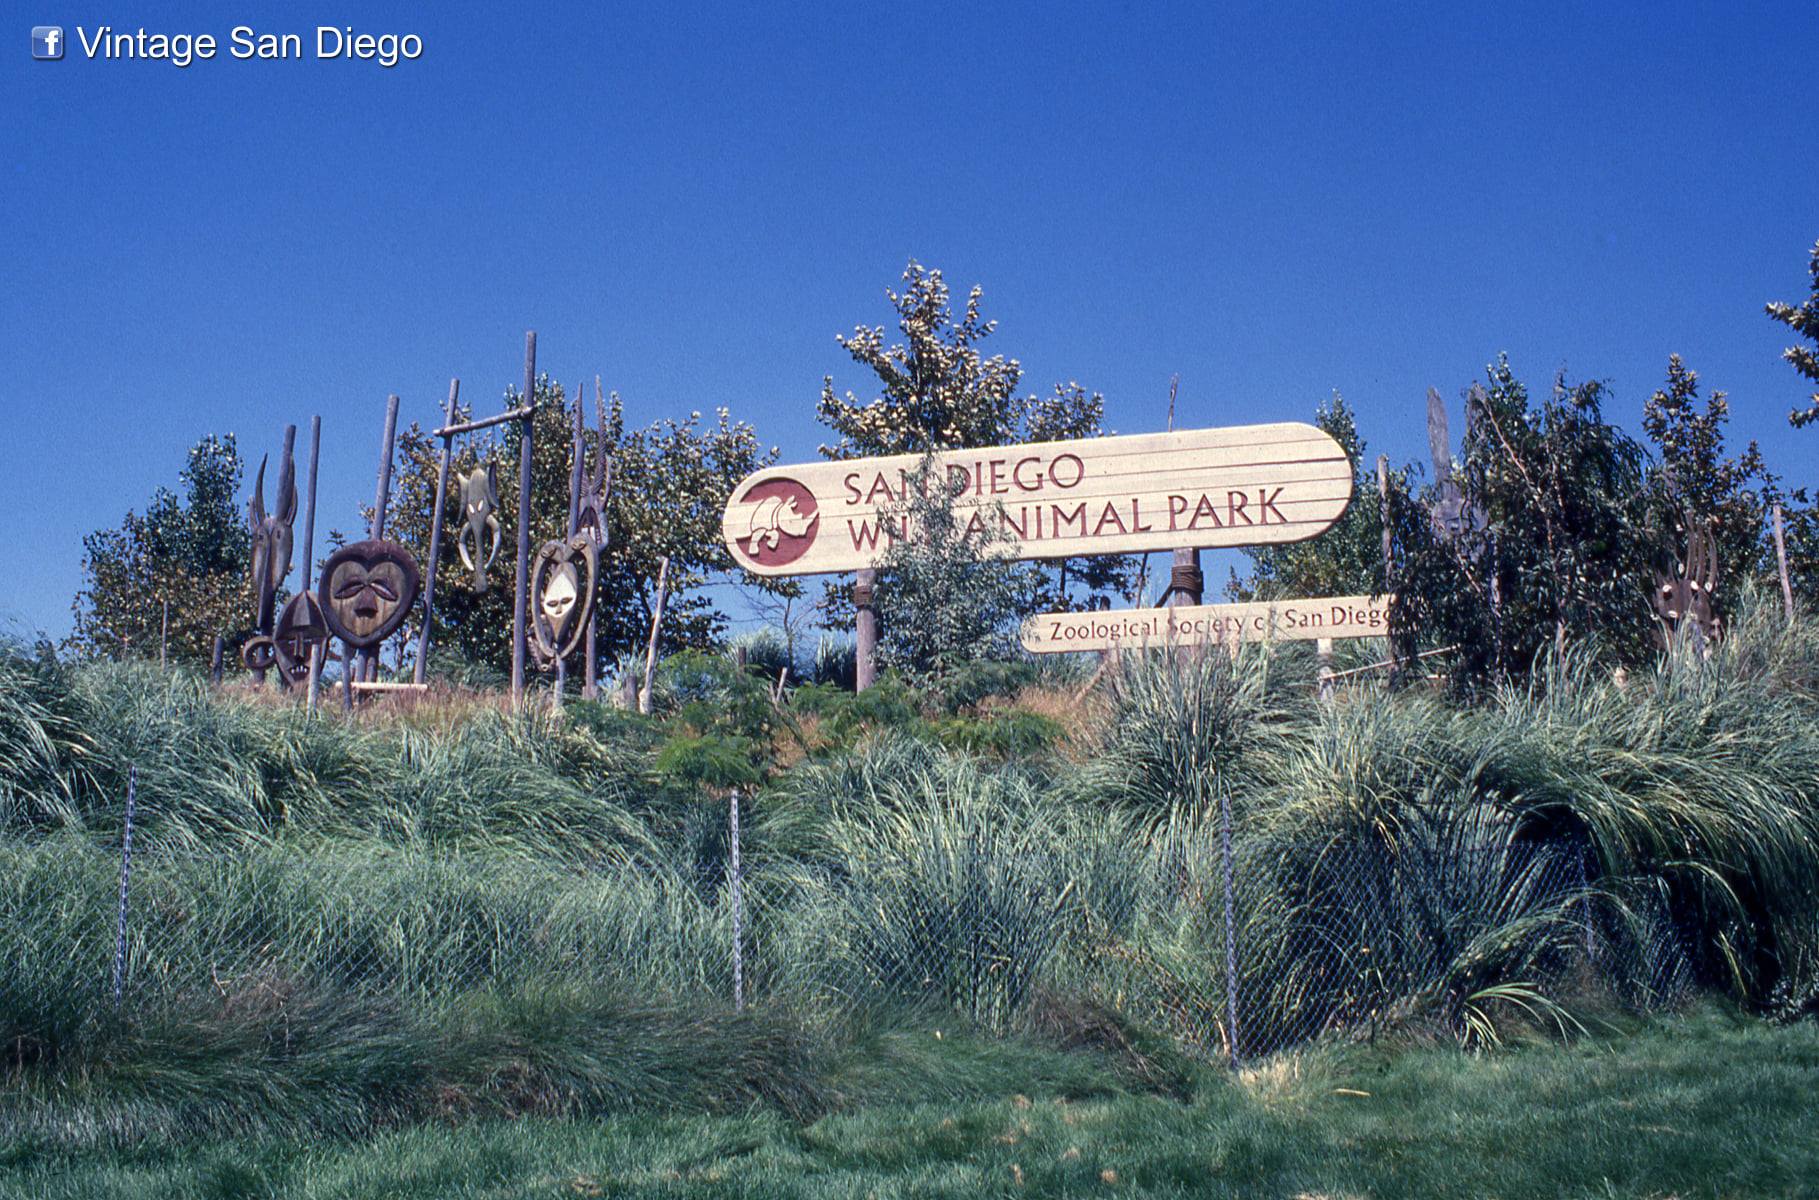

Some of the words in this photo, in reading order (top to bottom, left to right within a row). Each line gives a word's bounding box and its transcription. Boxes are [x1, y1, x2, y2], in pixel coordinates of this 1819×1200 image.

[945, 453, 1085, 498] DIEGO
[961, 498, 1152, 545] ANIMAL
[1167, 487, 1289, 531] PARK
[1050, 617, 1158, 641] Zoological
[1285, 608, 1324, 629] San
